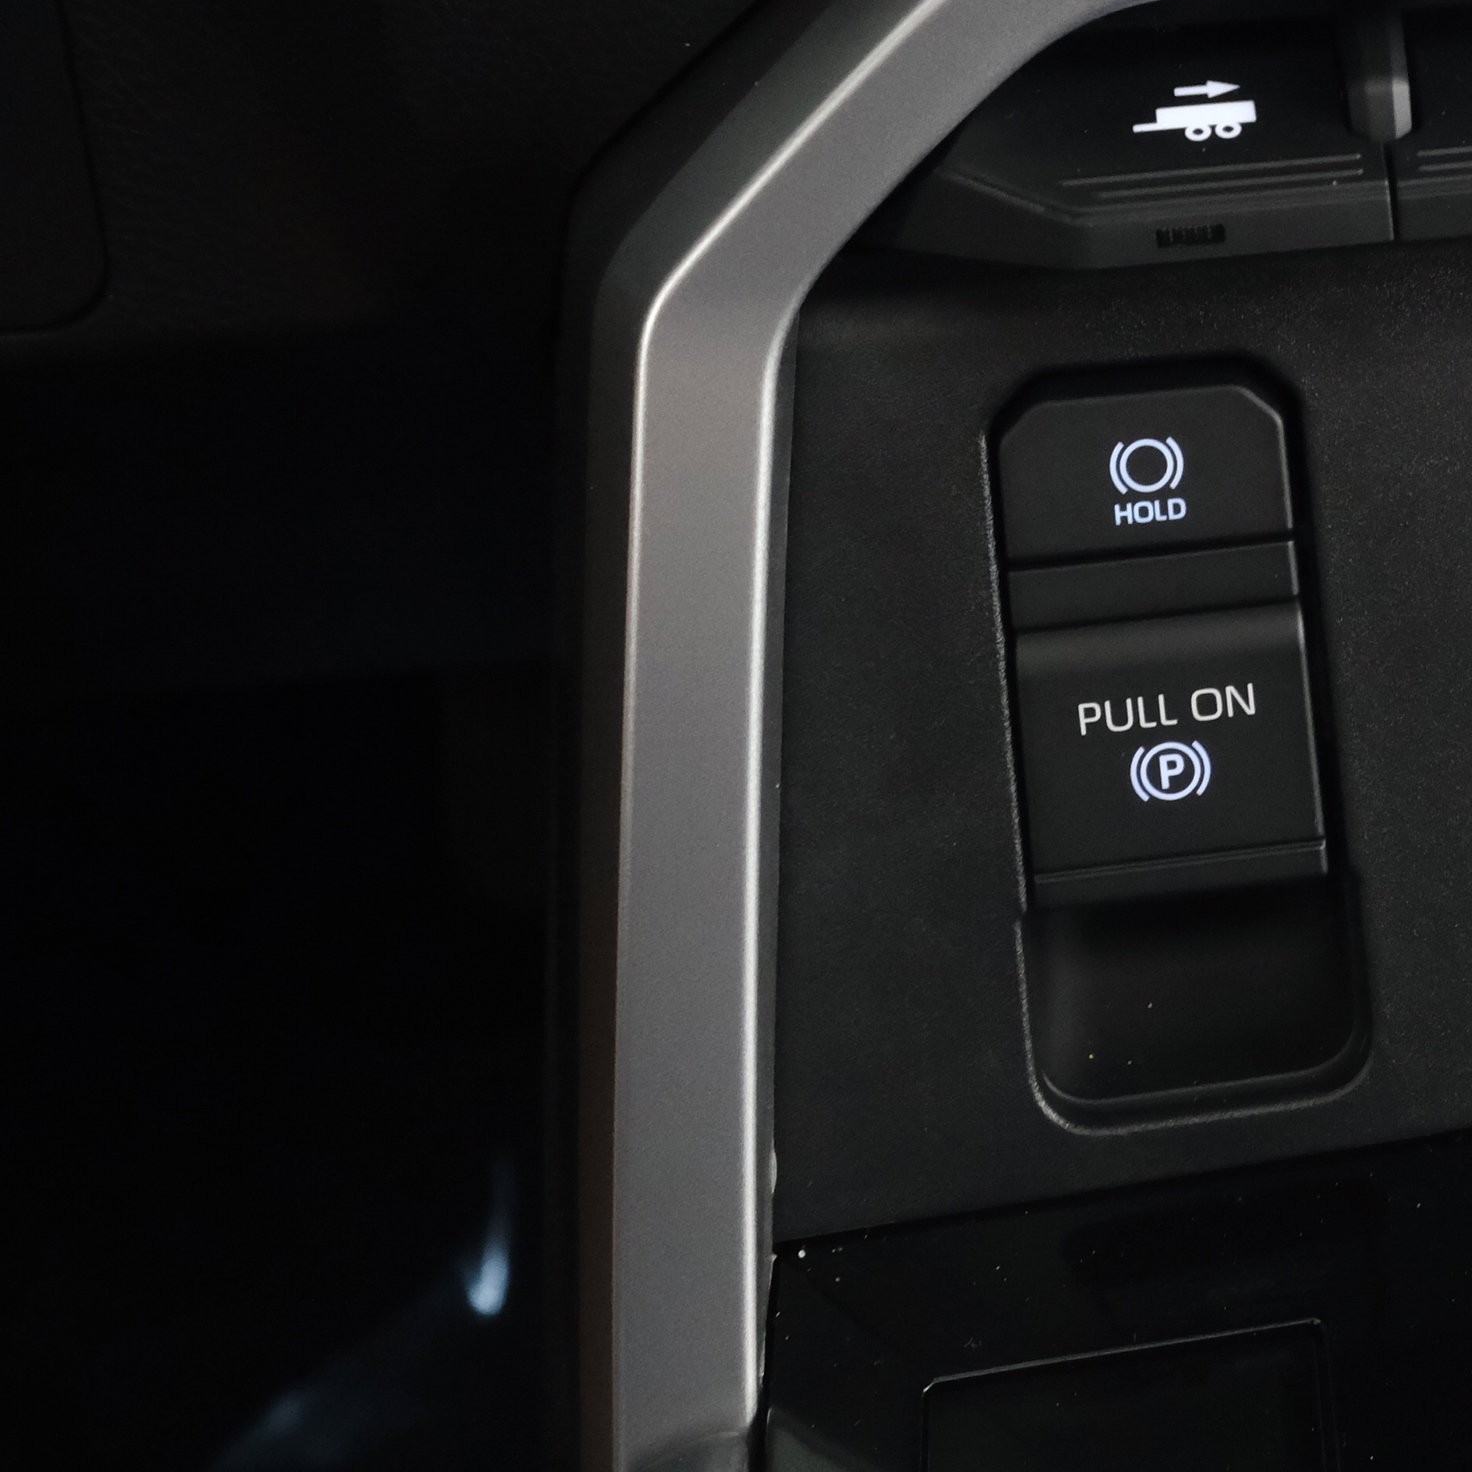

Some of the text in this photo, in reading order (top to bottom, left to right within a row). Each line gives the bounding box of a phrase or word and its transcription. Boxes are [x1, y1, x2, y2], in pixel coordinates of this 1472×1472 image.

[1113, 497, 1187, 526] HOLD
[1077, 682, 1257, 736] PULL ON
